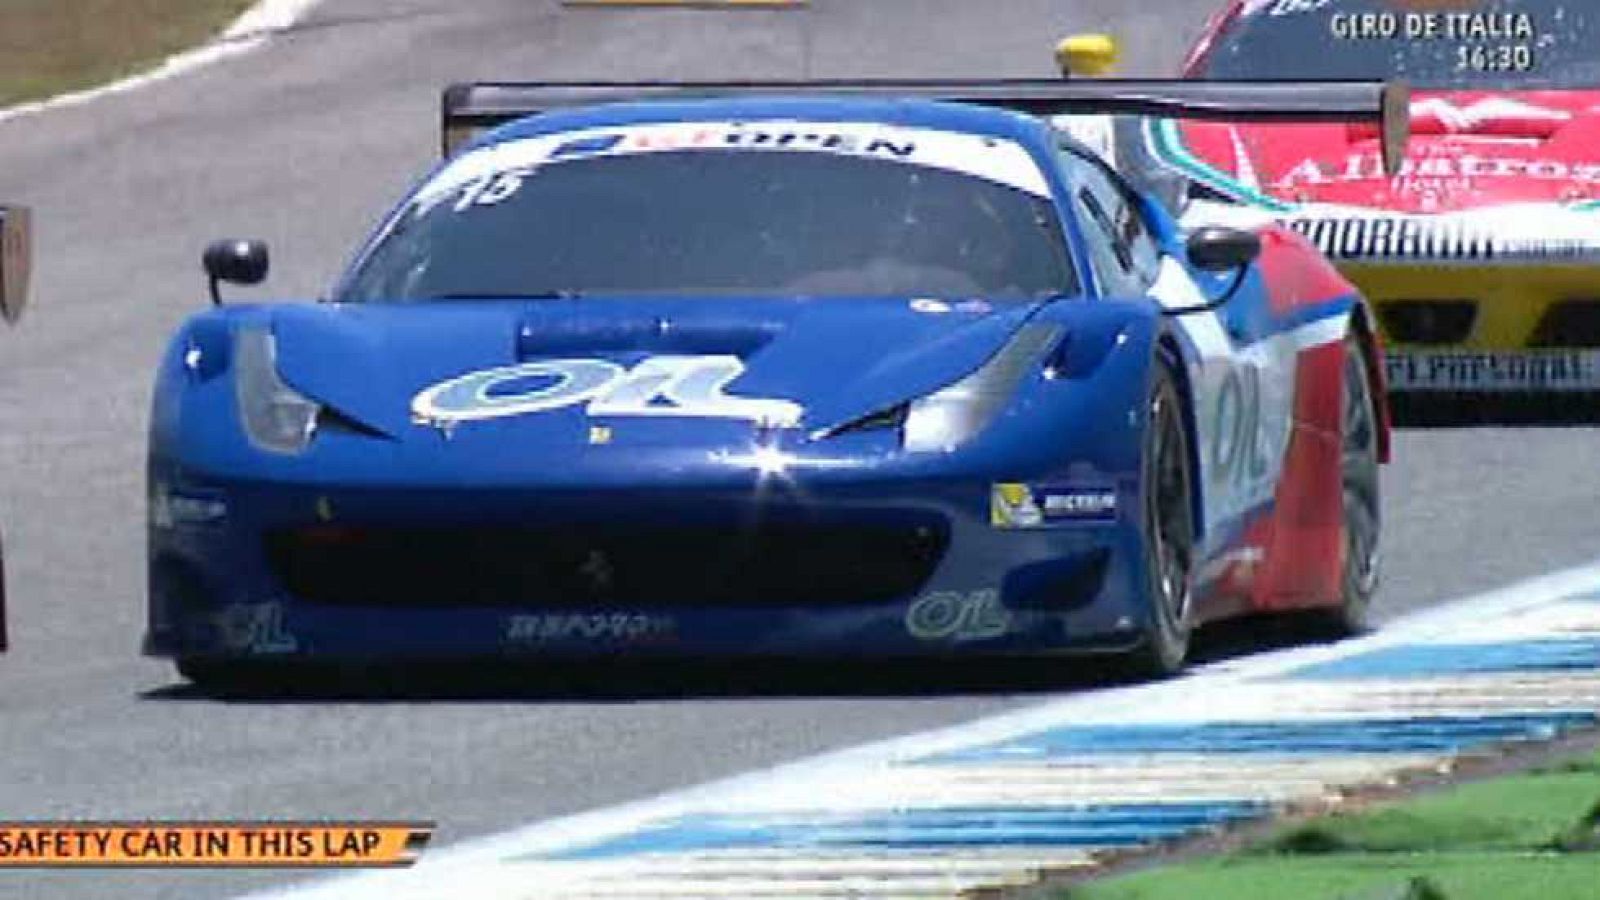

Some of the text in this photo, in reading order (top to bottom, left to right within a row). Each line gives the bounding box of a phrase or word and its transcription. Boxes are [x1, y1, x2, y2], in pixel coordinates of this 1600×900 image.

[722, 128, 916, 158] OPEN
[410, 354, 805, 424] OIL
[907, 588, 1006, 639] OIL
